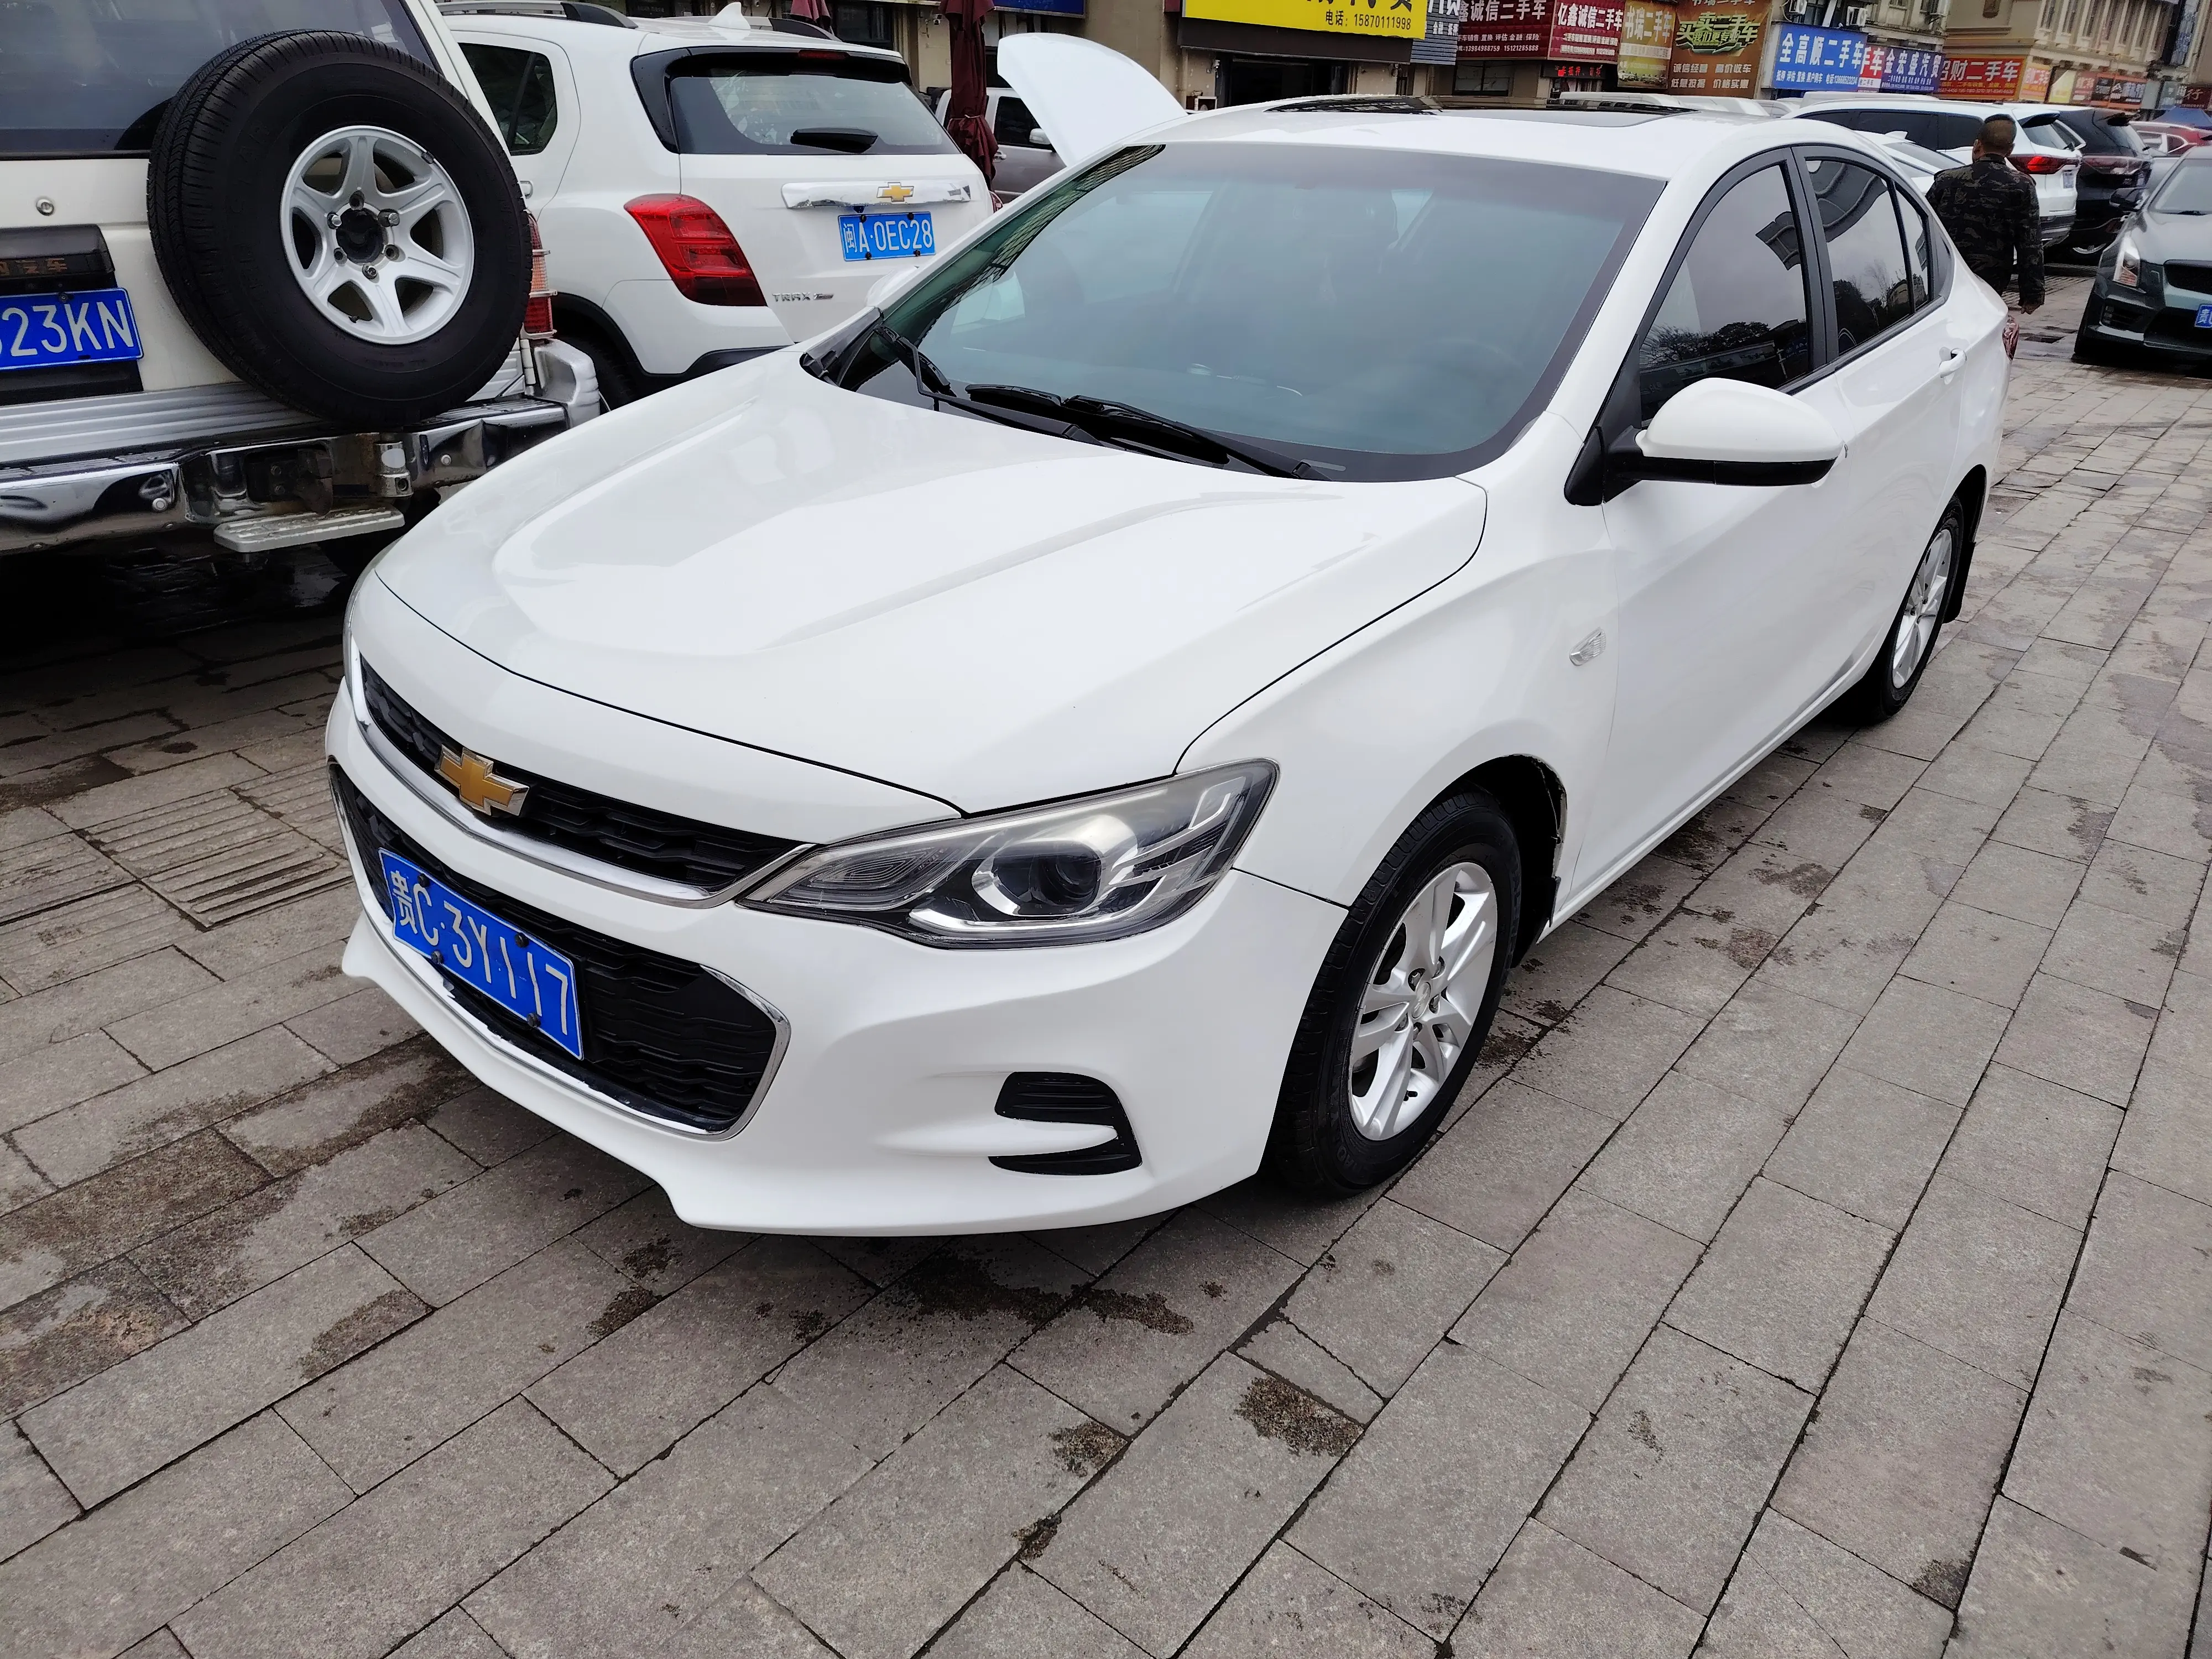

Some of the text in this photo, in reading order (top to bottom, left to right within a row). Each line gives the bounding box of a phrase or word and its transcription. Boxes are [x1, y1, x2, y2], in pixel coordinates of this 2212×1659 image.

[1354, 13, 1412, 30] 15870111998
[1558, 3, 1624, 31] 亿鑫诚信二手车
[1779, 33, 1864, 69] 全高顺二手车
[1715, 64, 1752, 74] 高价收车
[772, 292, 811, 302] TRAX
[0, 300, 134, 357] 23KN
